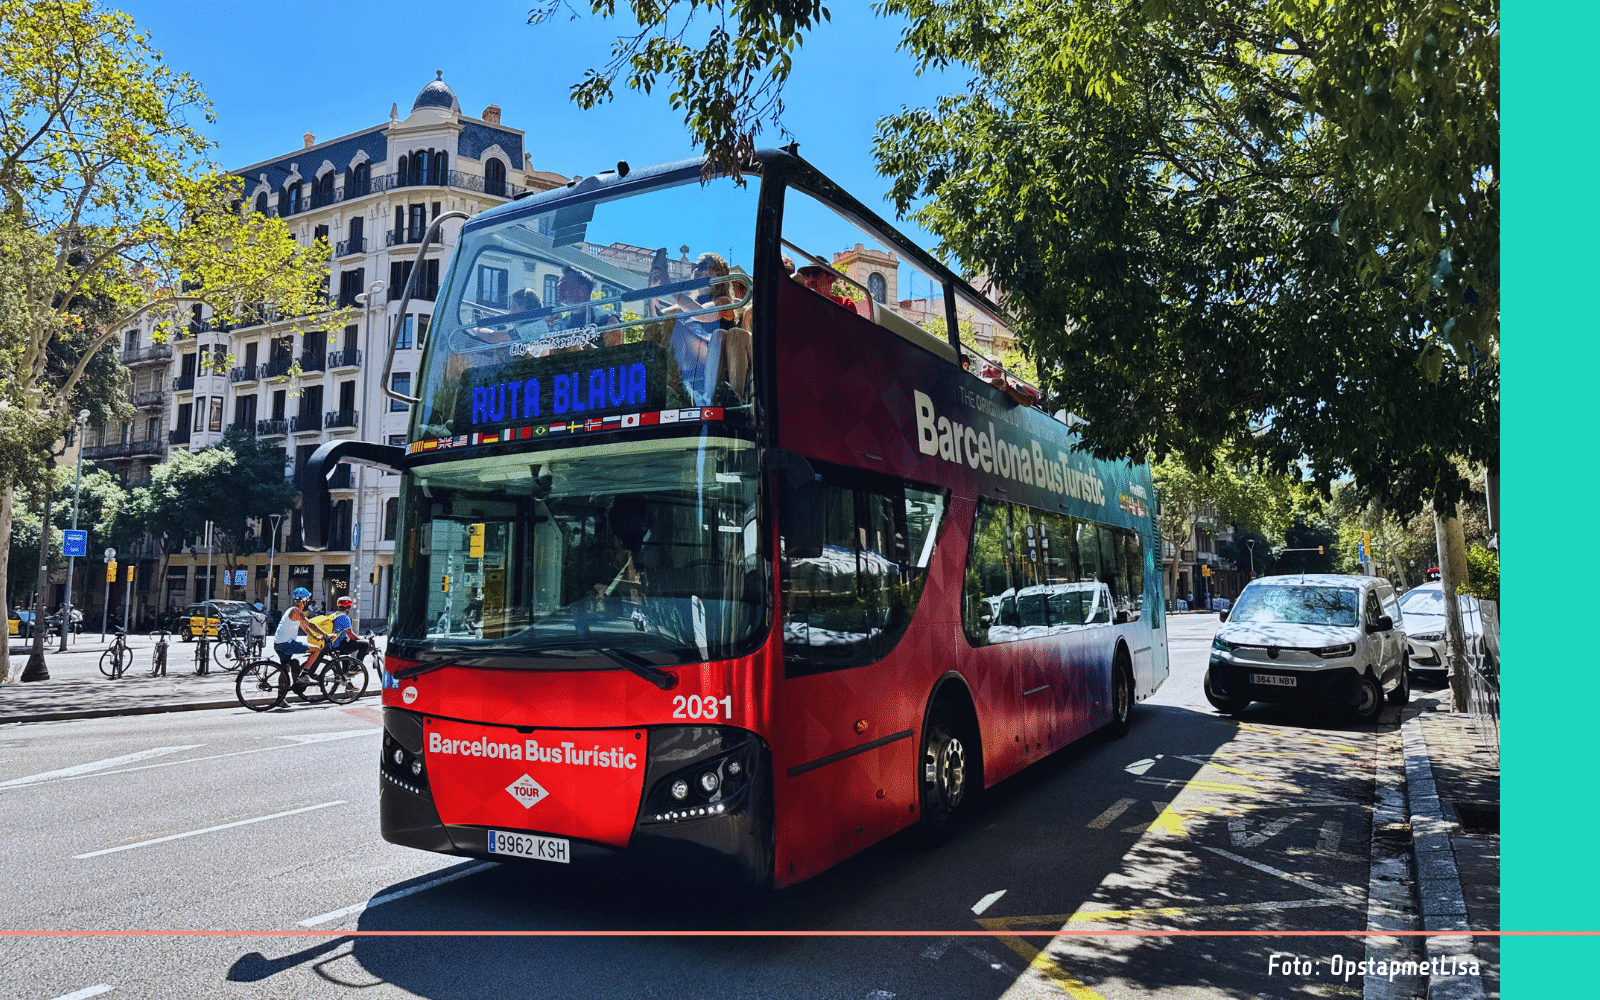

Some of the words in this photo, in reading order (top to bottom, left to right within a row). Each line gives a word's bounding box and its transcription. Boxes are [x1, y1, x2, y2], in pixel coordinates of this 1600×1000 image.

[472, 378, 540, 424] RUTA
[554, 362, 646, 414] BLAVA
[959, 385, 975, 409] THE
[914, 389, 1033, 485] Barcelona
[1256, 675, 1276, 684] 3641
[1279, 677, 1295, 686] NBV
[672, 694, 731, 719] 2031
[429, 732, 522, 760] Barcelona
[525, 739, 637, 769] BusTurístic
[514, 786, 539, 797] TOUR
[498, 834, 533, 855] 9962
[538, 839, 566, 860] KSH
